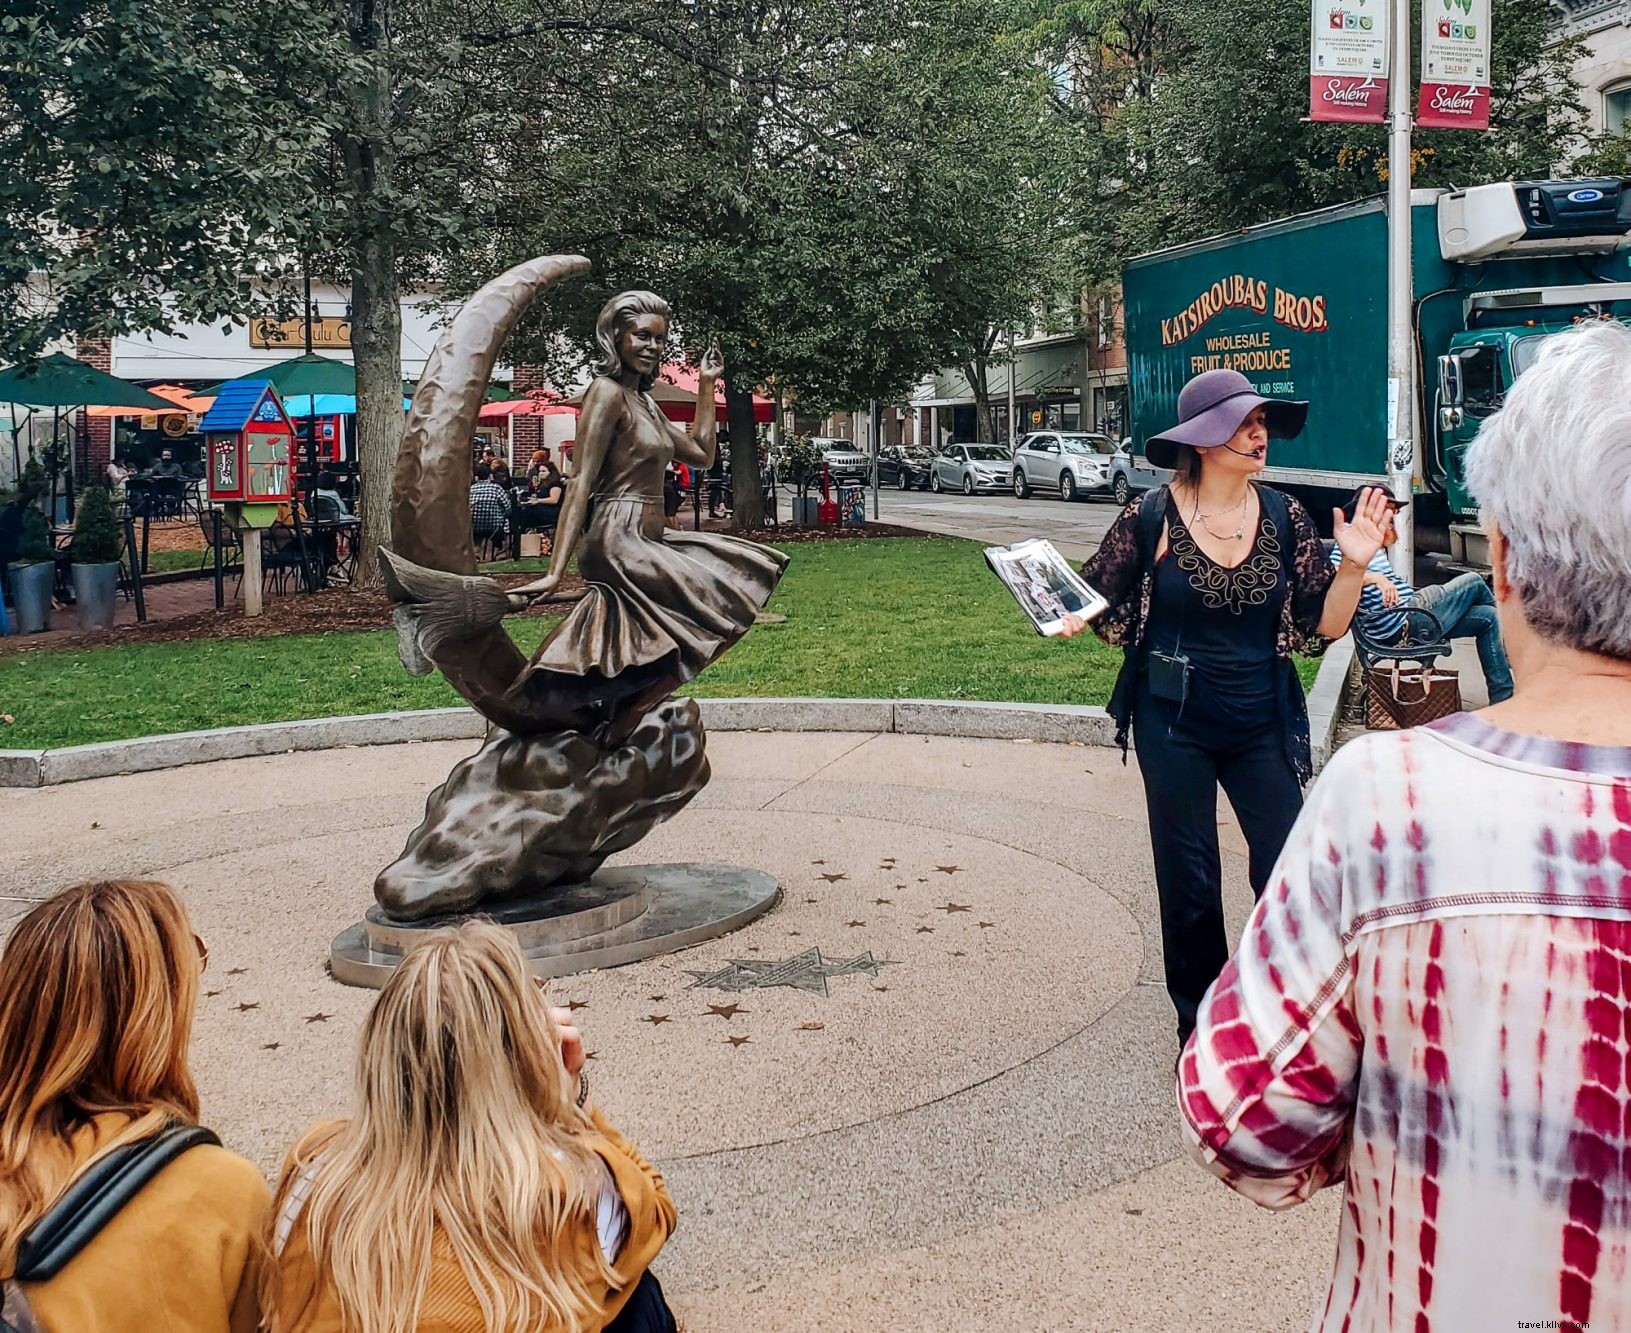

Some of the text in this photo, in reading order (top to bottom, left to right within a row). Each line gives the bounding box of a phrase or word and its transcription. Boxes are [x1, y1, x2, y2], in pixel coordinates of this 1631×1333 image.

[1323, 79, 1370, 102] Salem
[1430, 87, 1474, 110] Salem
[1161, 274, 1329, 346] KATSIROUBAS BROS.
[1206, 332, 1270, 352] WHOLESALE
[1190, 348, 1291, 374] FRUIT & PRODUCE
[1260, 383, 1270, 393] AND
[1272, 382, 1294, 394] SERVICE
